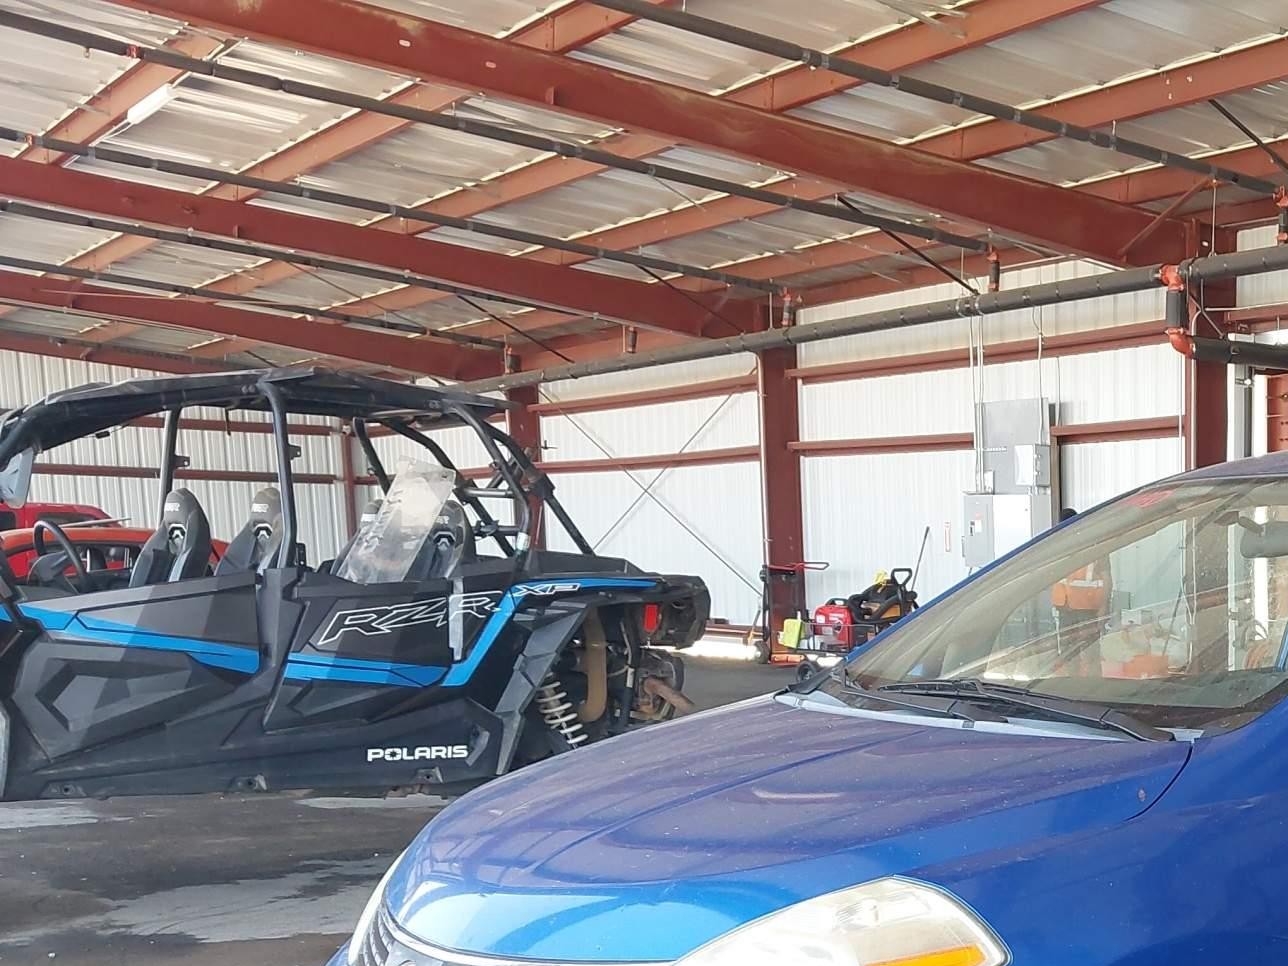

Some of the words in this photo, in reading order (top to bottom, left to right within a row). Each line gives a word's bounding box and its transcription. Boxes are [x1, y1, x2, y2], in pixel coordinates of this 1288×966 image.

[318, 590, 502, 645] RZR
[514, 583, 581, 597] XP
[367, 745, 469, 762] POLARIS
